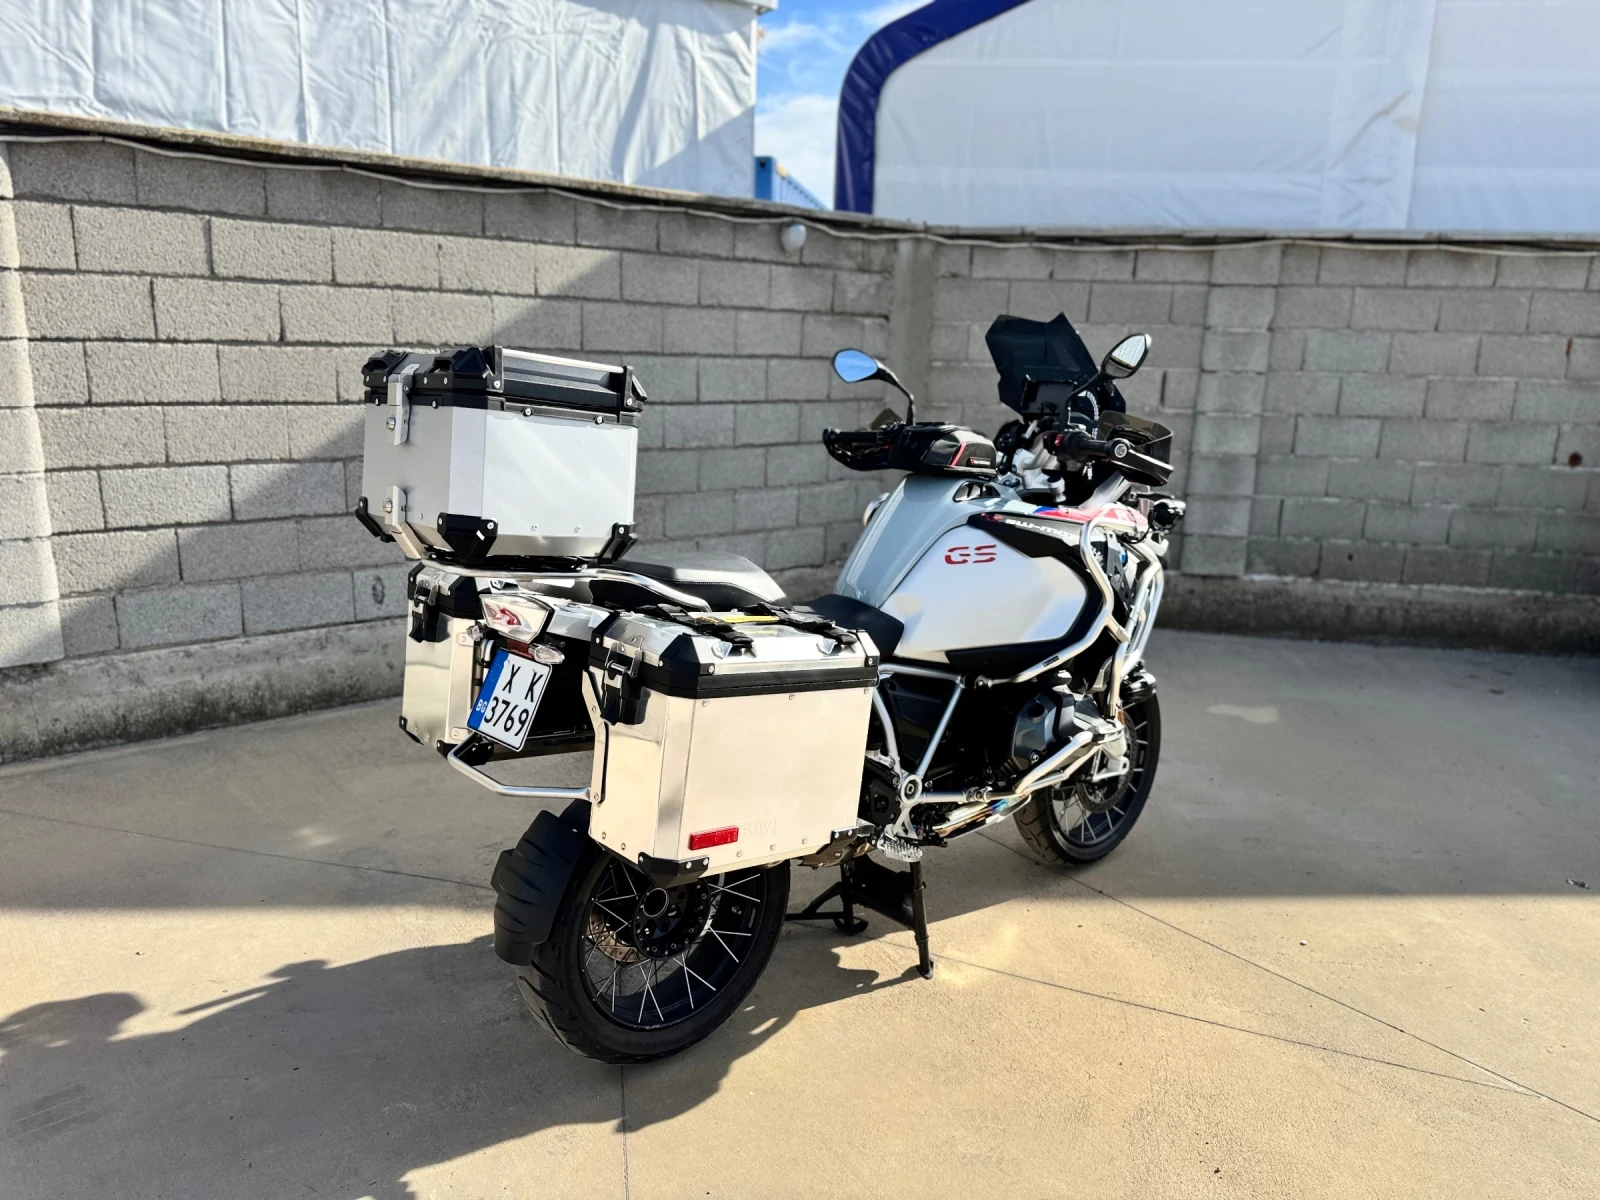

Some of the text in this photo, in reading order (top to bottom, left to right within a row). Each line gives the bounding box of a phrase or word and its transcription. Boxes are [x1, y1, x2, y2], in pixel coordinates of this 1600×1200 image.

[944, 544, 998, 565] GS
[502, 664, 544, 703] X K
[475, 698, 489, 713] BG
[484, 696, 530, 737] 3769
